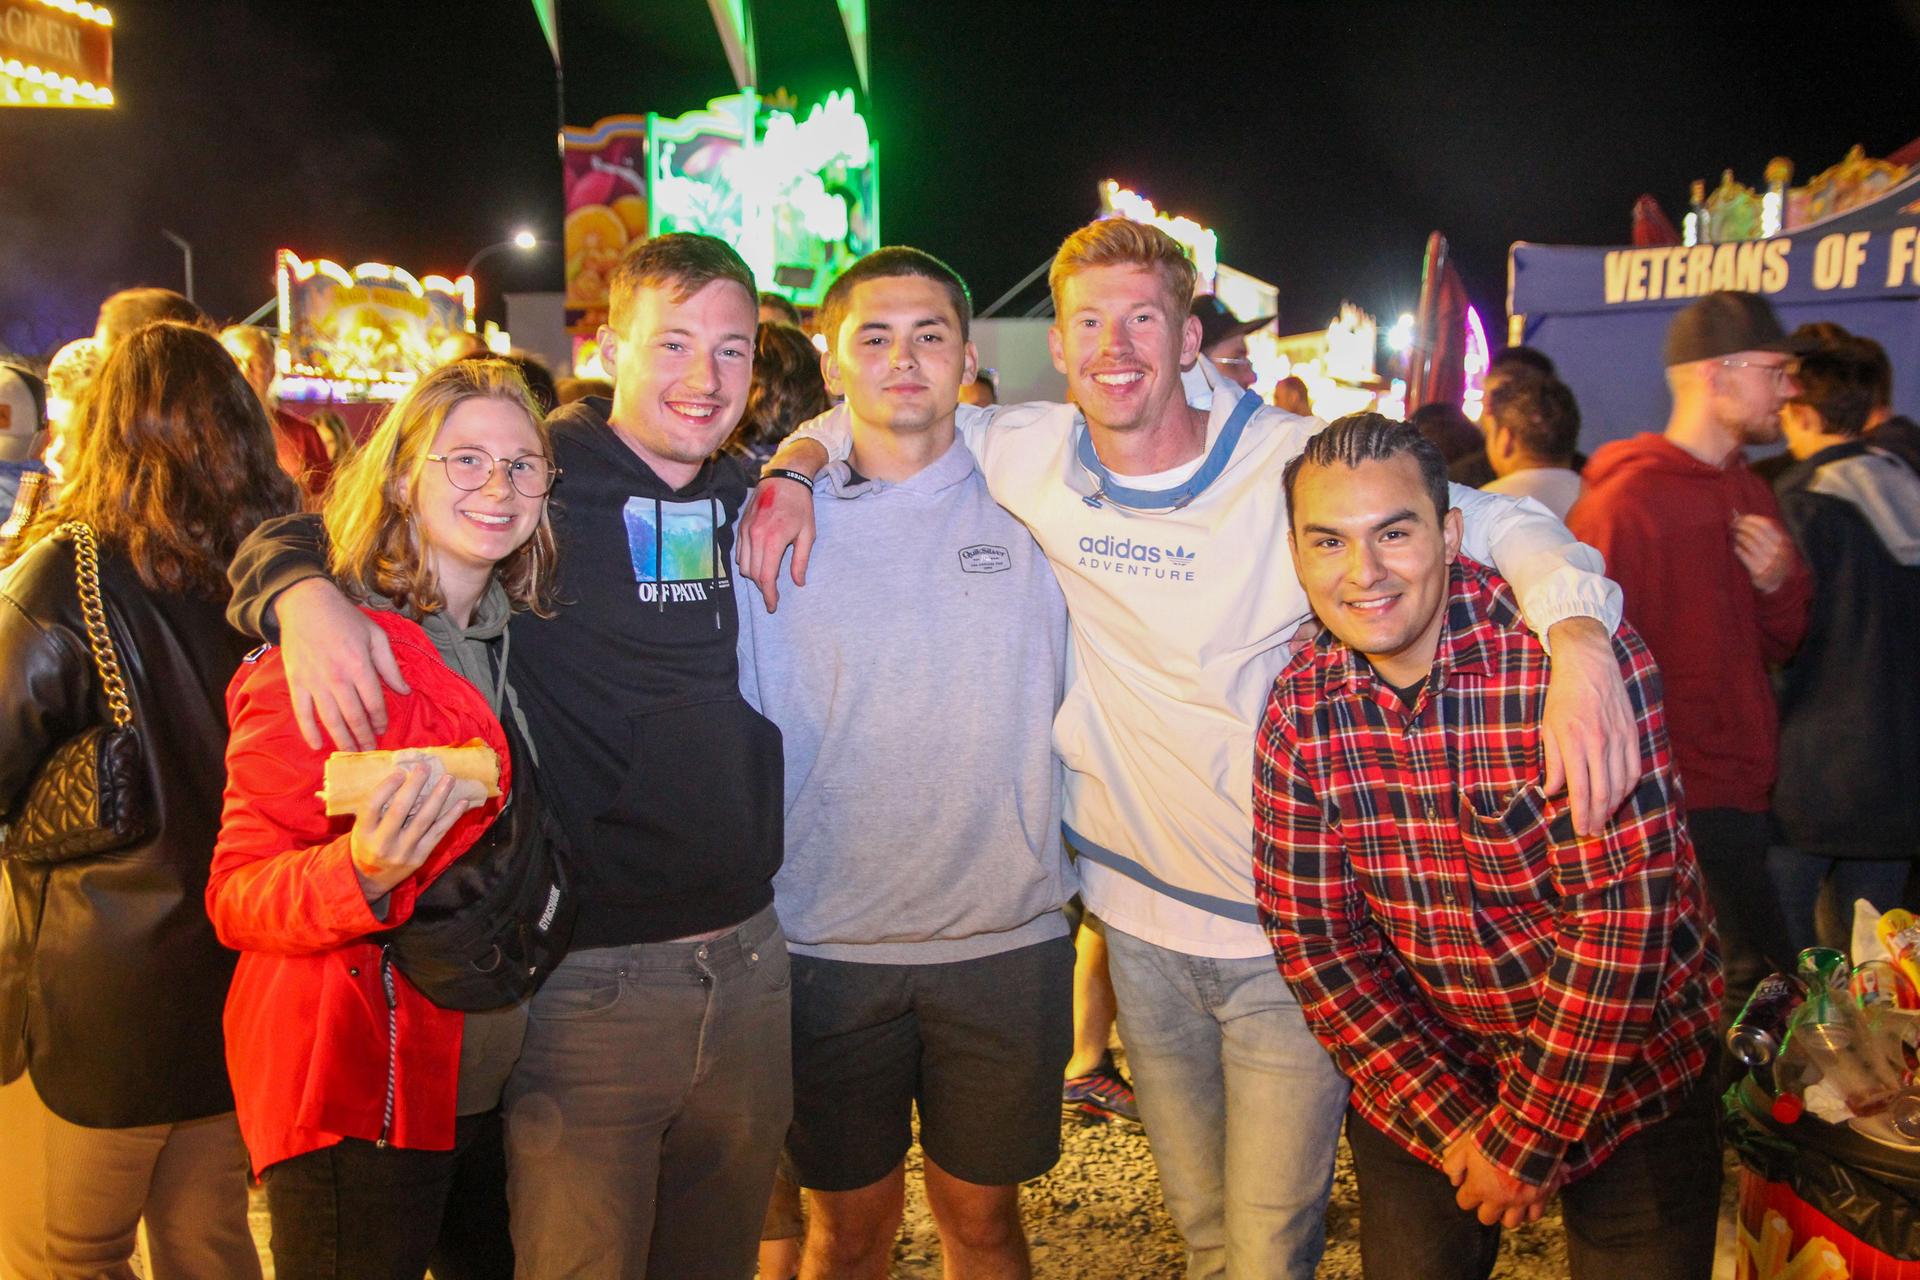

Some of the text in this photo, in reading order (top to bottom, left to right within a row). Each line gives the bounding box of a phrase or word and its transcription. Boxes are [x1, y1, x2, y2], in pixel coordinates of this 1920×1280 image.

[1604, 226, 1920, 304] VETERANS OF F
[1079, 536, 1161, 563] adidas
[1078, 557, 1195, 581] ADVENTURE
[670, 582, 707, 602] PATH
[539, 884, 560, 931] GYMSHARK
